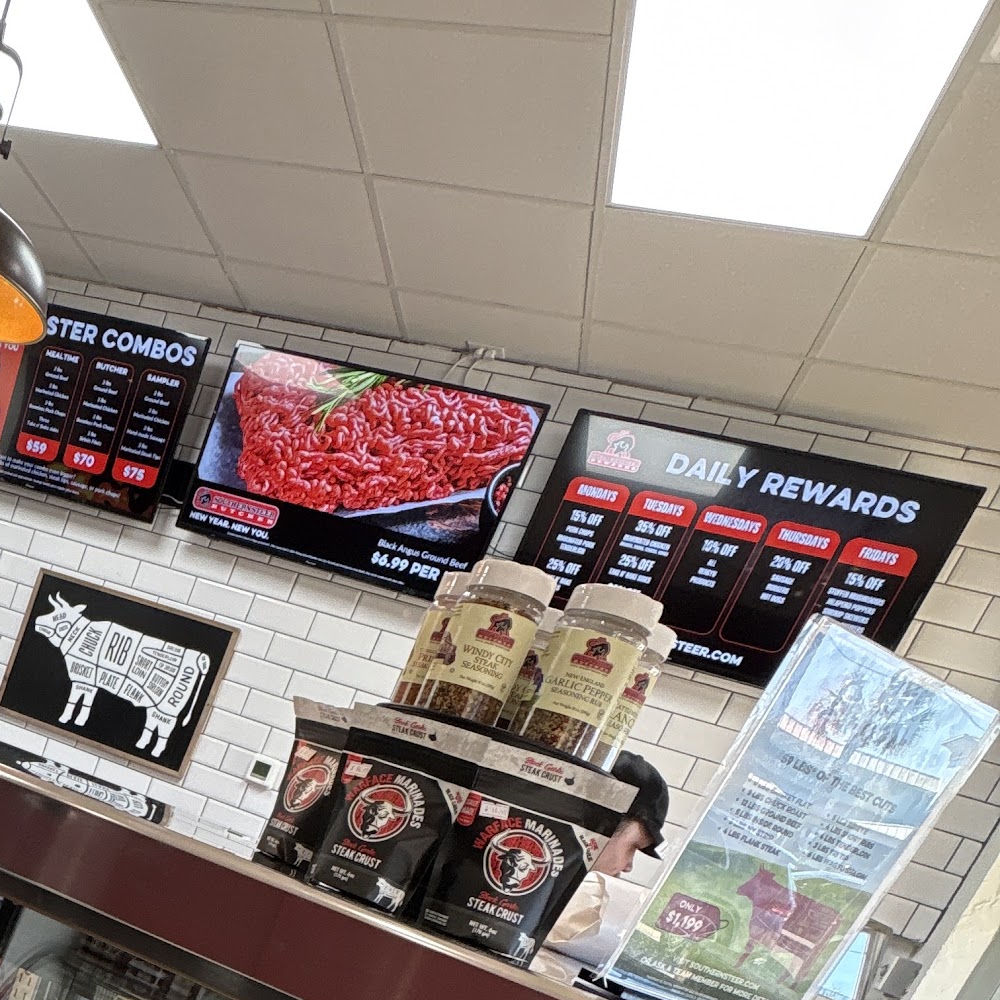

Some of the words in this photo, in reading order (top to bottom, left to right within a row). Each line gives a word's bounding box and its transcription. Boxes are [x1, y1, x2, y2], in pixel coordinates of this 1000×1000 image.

[45, 349, 80, 364] MEALTIME
[101, 328, 197, 367] COMBOS
[96, 362, 128, 376] BUTCHER
[147, 374, 180, 388] SAMPLER
[26, 439, 47, 454] $59
[73, 452, 95, 467] $70
[123, 465, 145, 481] $75
[577, 483, 619, 503] MONDAYS
[665, 452, 758, 489] DAILY
[760, 472, 921, 524] REWARDS
[642, 497, 685, 517] TUESDAYS
[189, 510, 208, 523] NEW
[231, 521, 251, 534] NEW
[570, 509, 588, 524] 15%
[587, 513, 604, 527] OFF
[703, 511, 762, 534] WEDNESDAYS
[634, 519, 656, 535] 35%
[655, 524, 673, 538] OFF
[701, 539, 722, 556] 10%
[720, 543, 739, 558] OFF
[777, 528, 831, 550] THURSDAYS
[377, 538, 397, 551] Black
[397, 544, 420, 557] Angus
[421, 550, 449, 565] Ground
[449, 558, 469, 570] Beef
[617, 553, 639, 569] 25%
[637, 558, 656, 573] OFF
[858, 546, 899, 566] FRIDAYS
[371, 551, 409, 572] $6.99
[409, 561, 441, 581] PER
[546, 558, 567, 574] 25%
[565, 562, 582, 576] OFF
[769, 555, 793, 571] 20%
[791, 559, 812, 575] OFF
[844, 572, 866, 588] 15%
[865, 576, 886, 591] OFF
[52, 612, 67, 622] HEAD
[67, 626, 80, 642] NECK
[79, 626, 103, 657] CHUCK
[104, 632, 132, 666] RIB
[463, 644, 495, 659] WINDY
[495, 654, 514, 668] CITY
[671, 639, 744, 667] STEER.COM
[70, 661, 94, 679] BRISKET
[131, 665, 148, 679] LOIN
[134, 655, 153, 671] SHORT
[460, 660, 503, 680] SEASONING
[473, 656, 500, 670] STEAK
[75, 685, 93, 693] SHANK
[99, 671, 120, 690] PLATE
[168, 666, 195, 707] ROUND
[545, 676, 582, 691] GARLIC
[582, 684, 613, 704] PEPPER
[566, 672, 579, 680] NEW
[580, 675, 605, 689] ENGLAND
[123, 683, 145, 703] FLANK
[551, 686, 590, 703] SEASONING
[151, 711, 172, 725] SHANK
[392, 724, 409, 737] STEAK
[409, 729, 427, 740] CRUST
[519, 764, 540, 778] STEAK
[540, 770, 563, 784] CRUST
[817, 769, 830, 783] OF
[830, 776, 850, 794] THE
[850, 784, 874, 802] BEST
[345, 773, 394, 801] WARFACE
[393, 774, 426, 829] MARINADES
[473, 817, 523, 850] WARFACE
[524, 818, 565, 878] MARINADES
[740, 834, 761, 849] FLANK
[761, 842, 782, 857] STEAK
[331, 844, 354, 861] STEAK
[354, 852, 381, 870] CRUST
[467, 896, 495, 917] STEAK
[495, 906, 524, 925] CRUST
[679, 900, 702, 913] ONLY
[665, 911, 704, 932] $1,199
[652, 960, 666, 971] ASK
[665, 964, 672, 972] A
[673, 966, 691, 980] TEAM
[692, 973, 720, 989] MEMBER
[719, 982, 733, 993] FOR
[733, 987, 751, 1000] MORE
[689, 961, 761, 990] SOUTHERNSTEER.COM
